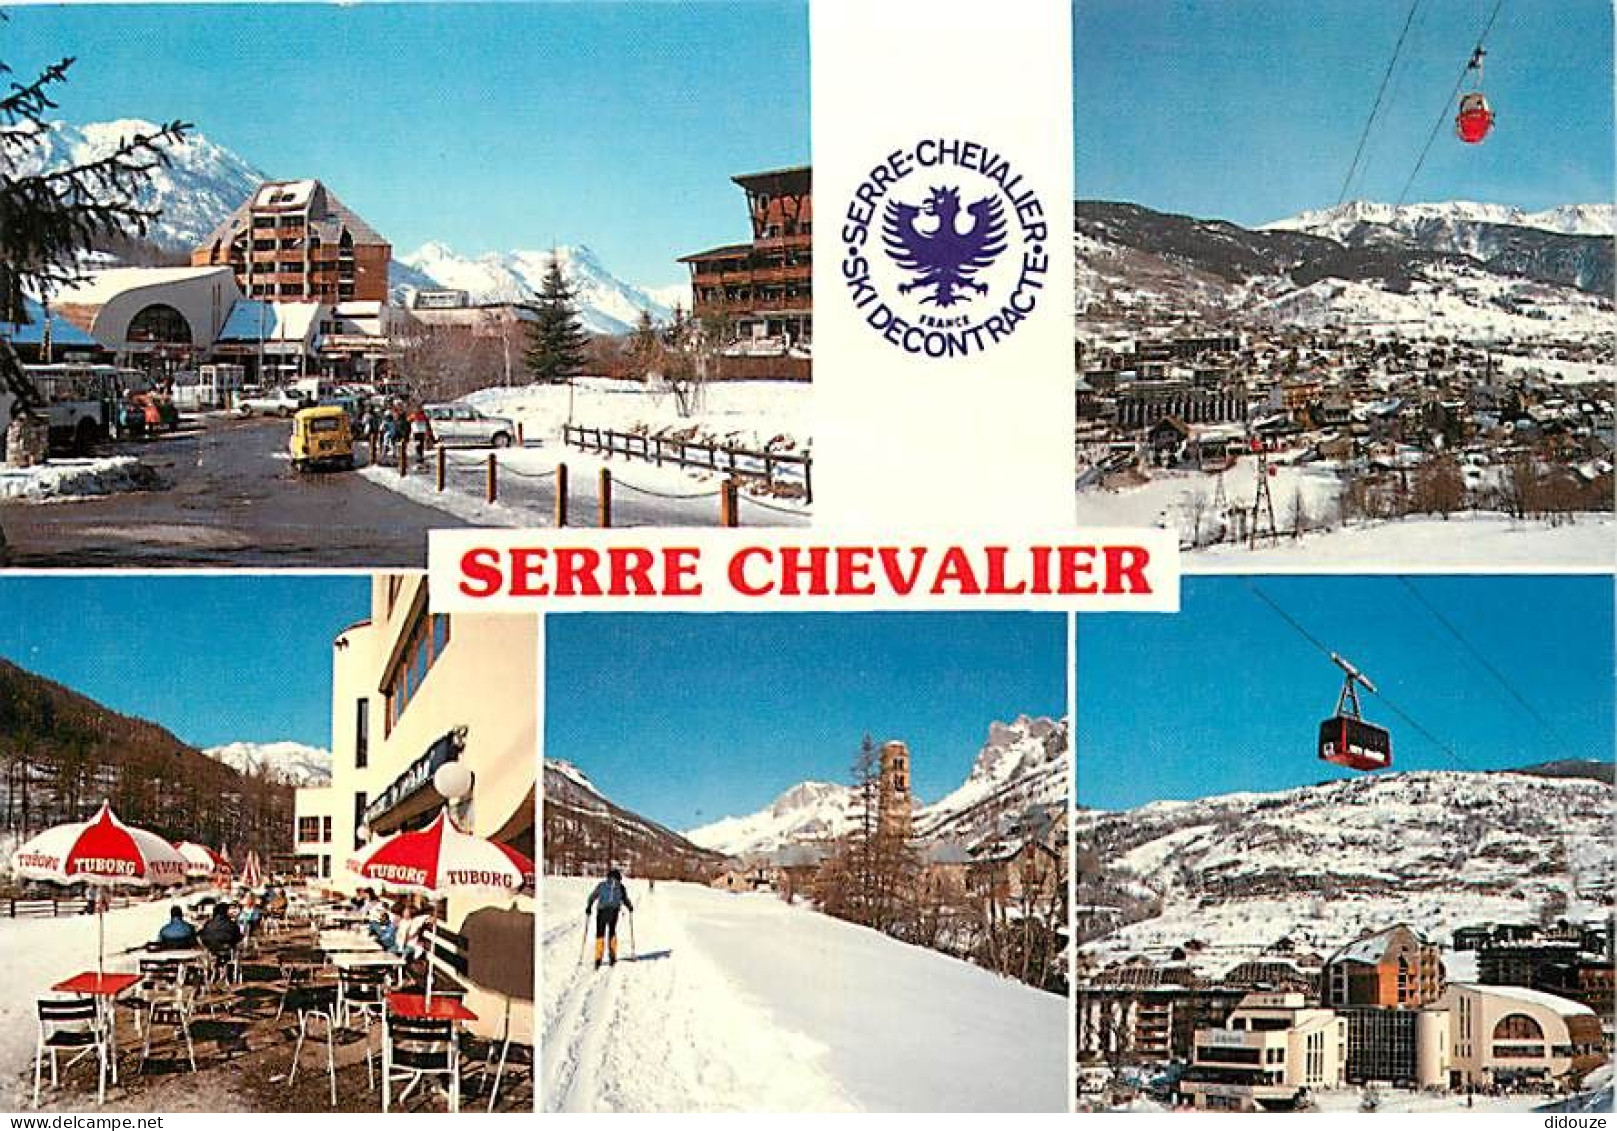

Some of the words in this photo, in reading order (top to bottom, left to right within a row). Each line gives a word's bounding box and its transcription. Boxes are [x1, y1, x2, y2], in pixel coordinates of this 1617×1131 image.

[842, 138, 1047, 246] SERRE-CHEVALIER
[842, 257, 878, 309] SKI
[867, 252, 1048, 357] DECONTRACTE
[919, 314, 970, 328] FRANCE
[459, 548, 702, 597] SERRE
[728, 547, 1153, 597] CHEVALIER
[74, 858, 136, 875] TUBORG
[367, 864, 428, 884] TUBORG
[447, 870, 513, 889] TUBORG
